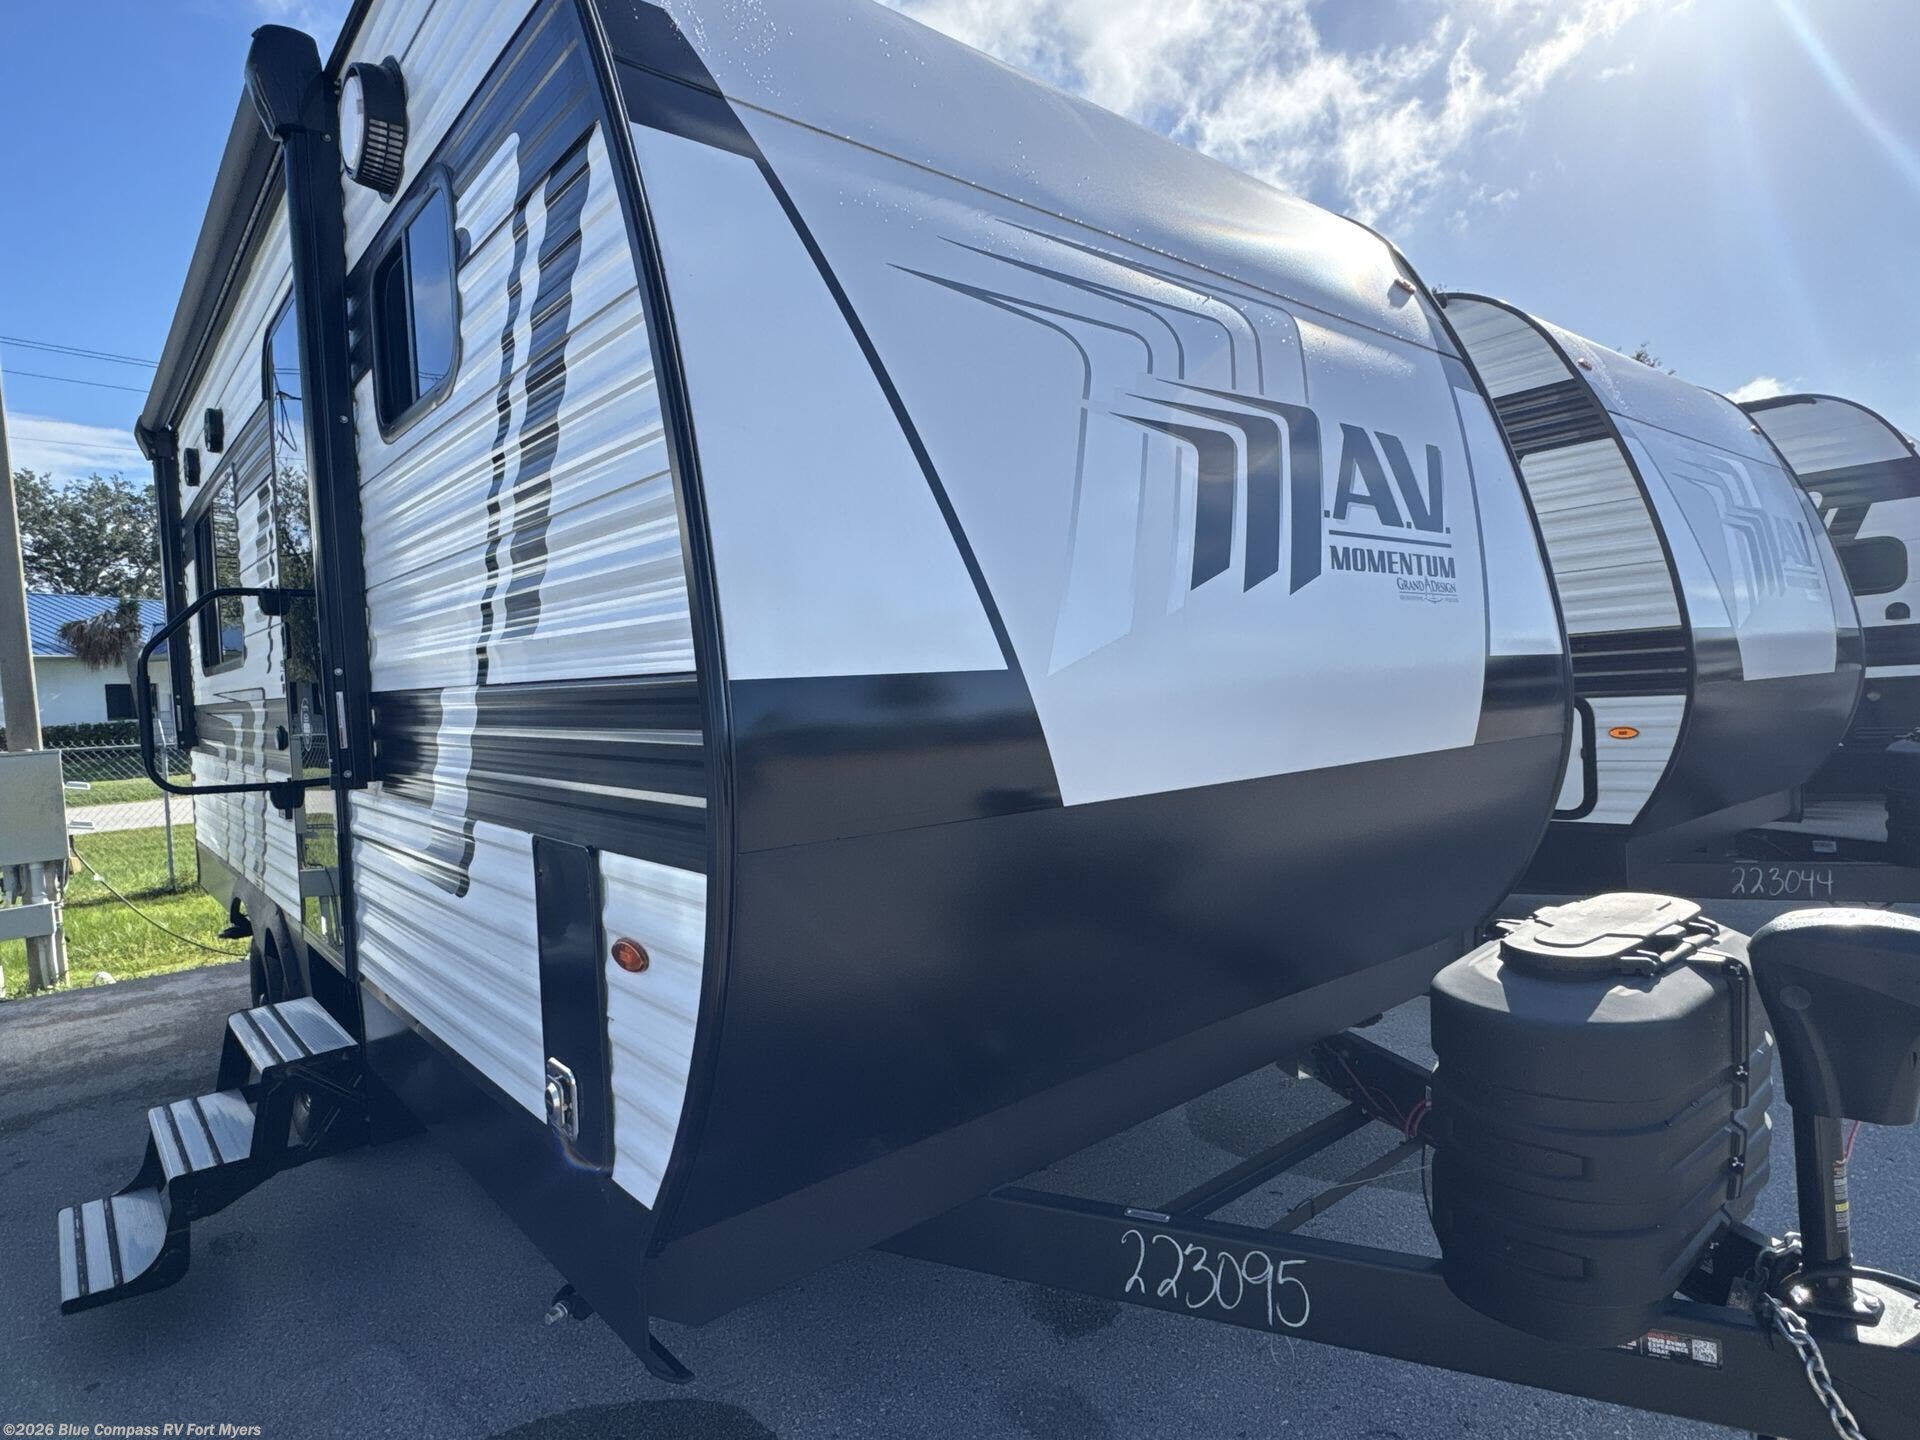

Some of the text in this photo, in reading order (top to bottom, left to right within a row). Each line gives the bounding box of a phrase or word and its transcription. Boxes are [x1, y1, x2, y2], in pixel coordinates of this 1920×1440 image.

[1329, 545, 1456, 579] MOMENTUM
[1731, 866, 1834, 897] 223044
[1121, 1229, 1310, 1328] 223095
